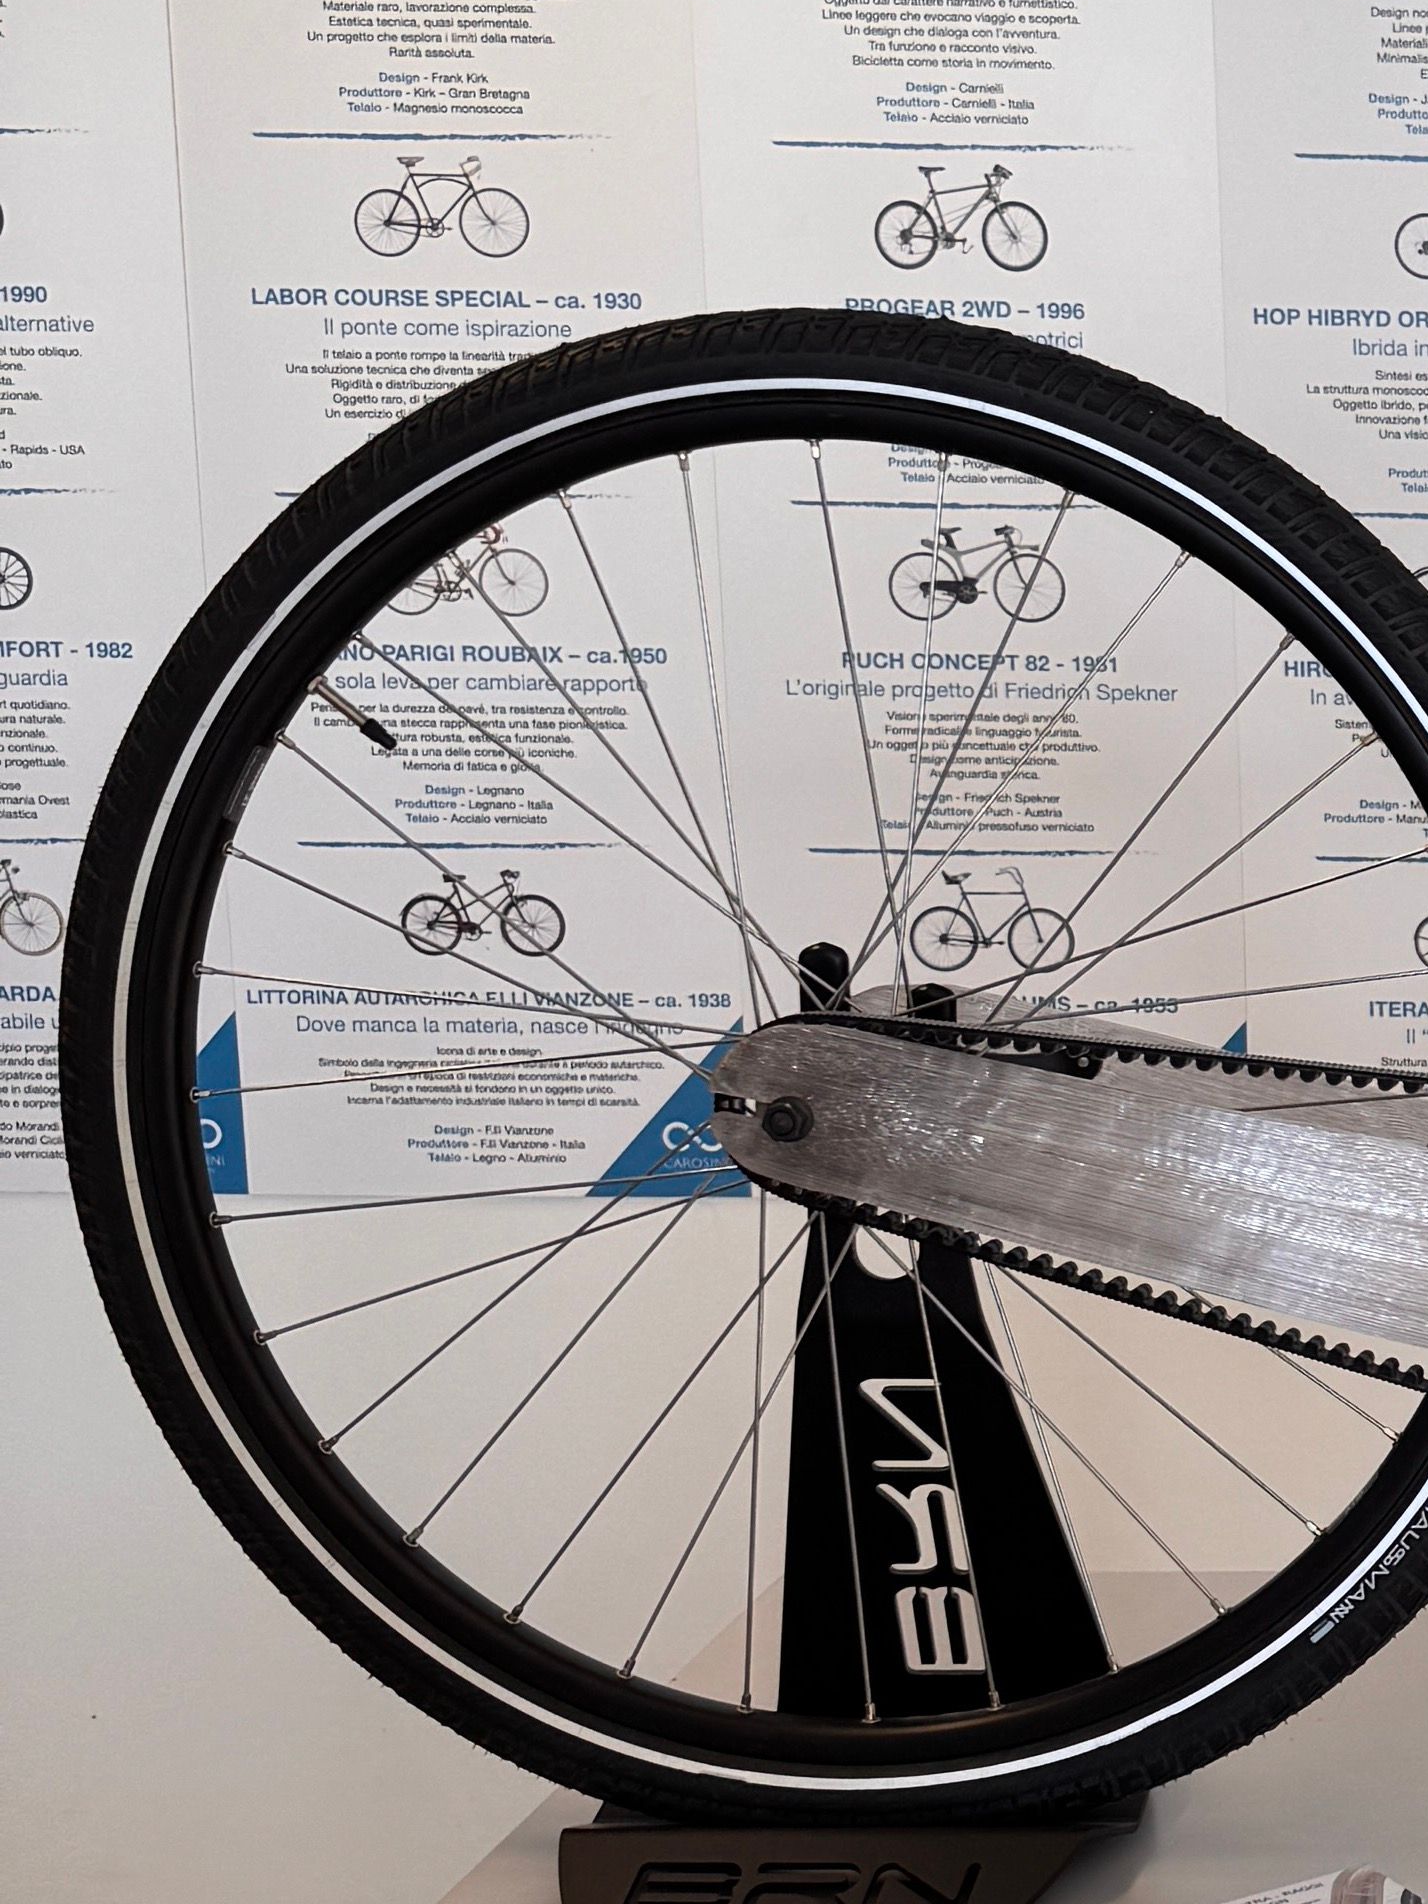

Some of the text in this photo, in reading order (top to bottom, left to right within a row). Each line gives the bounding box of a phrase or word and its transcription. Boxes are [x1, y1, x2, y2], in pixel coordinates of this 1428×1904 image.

[324, 317, 572, 341] Il ponte come ispirazione
[1352, 338, 1408, 357] Ibrida
[858, 1378, 986, 1675] BRN
